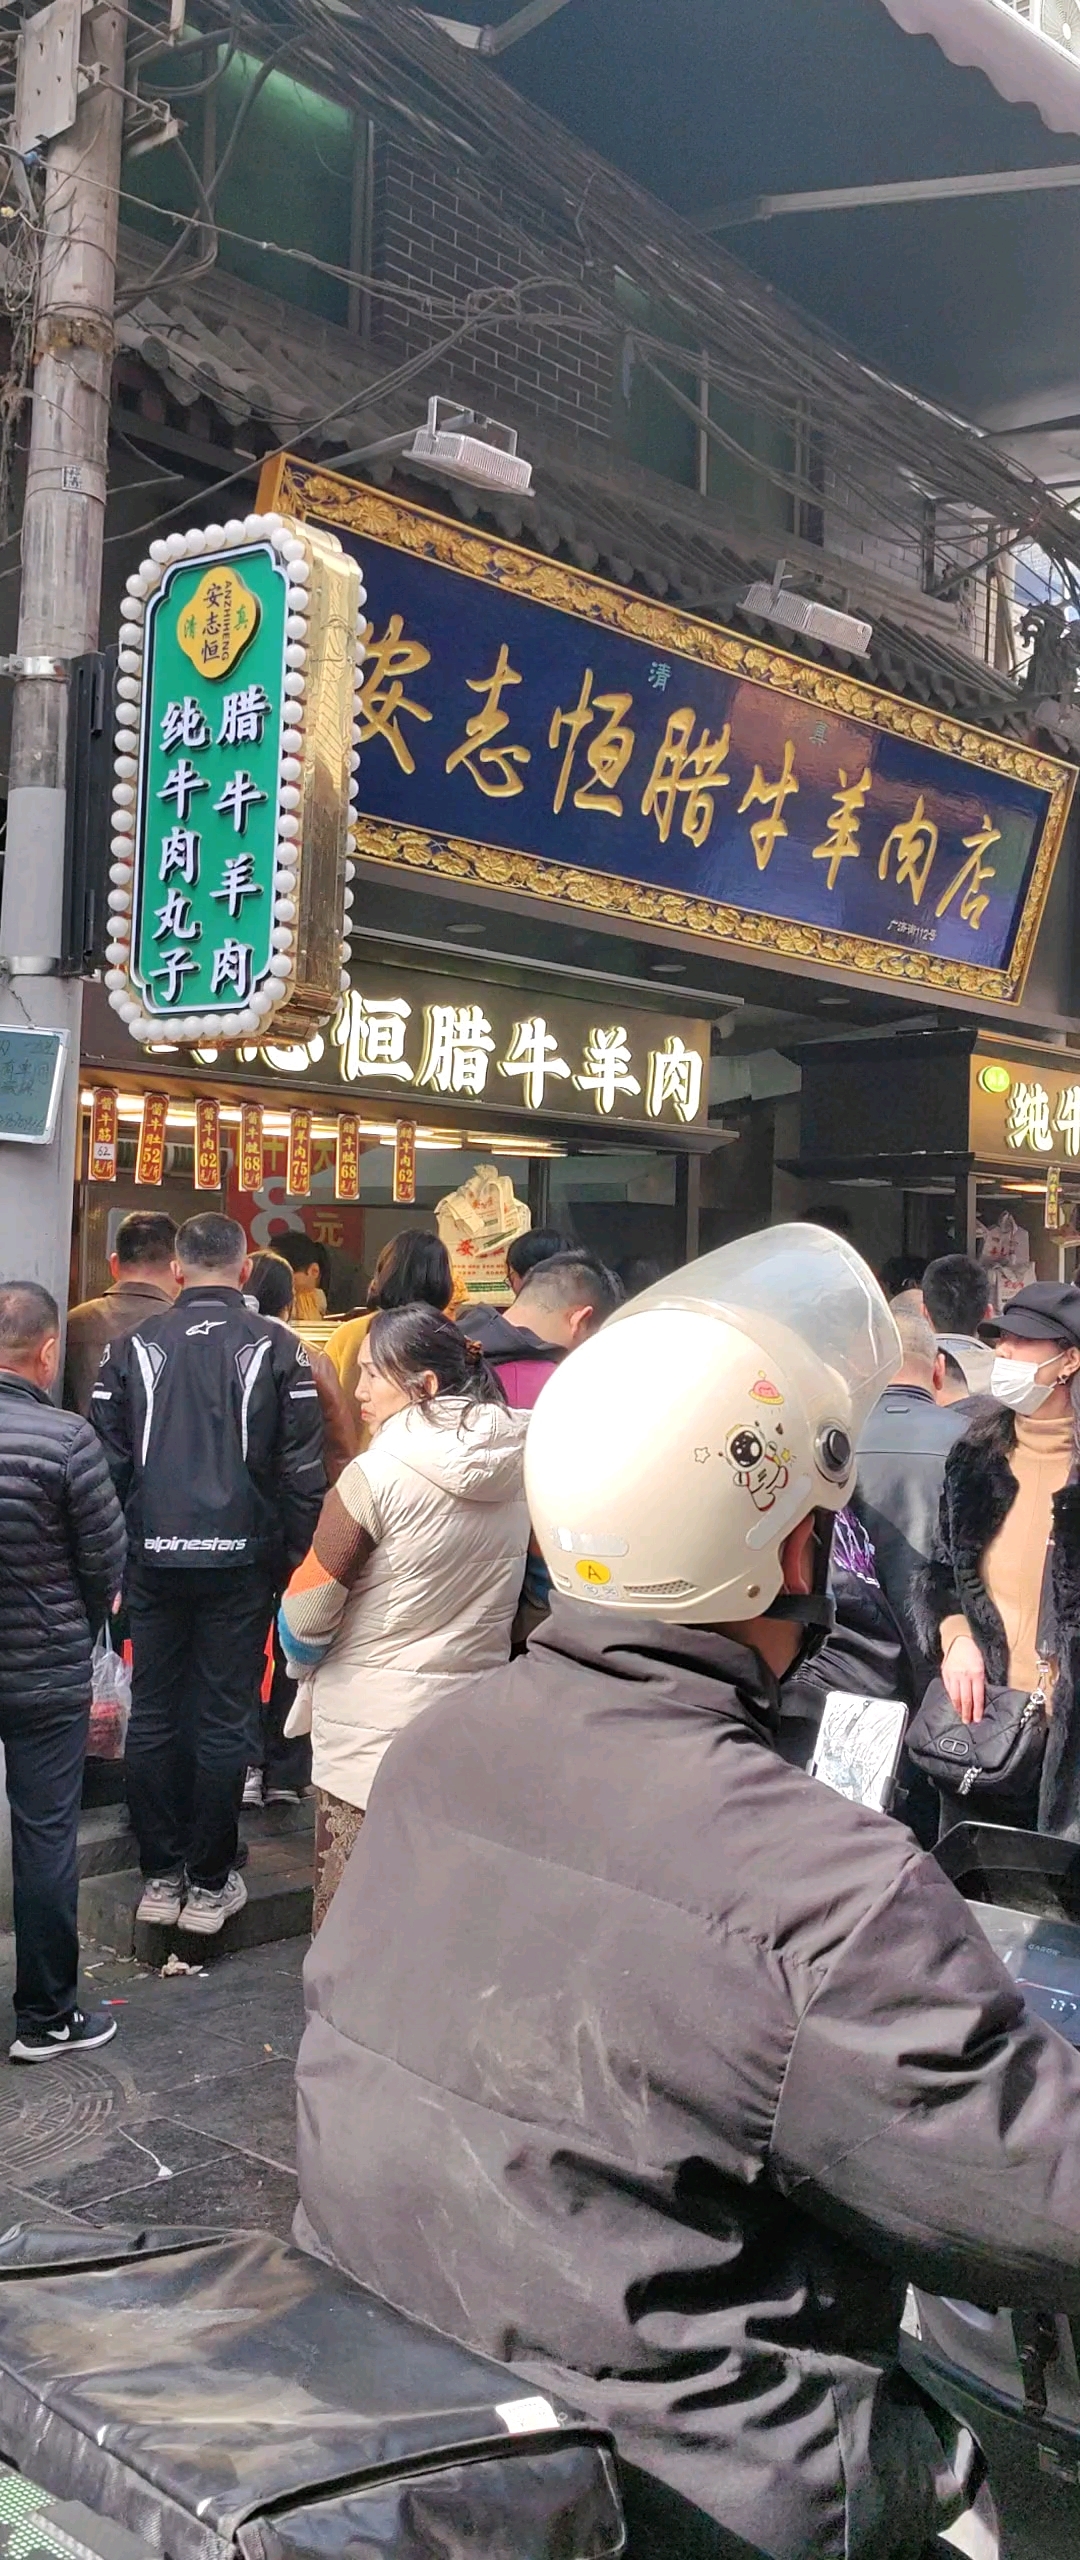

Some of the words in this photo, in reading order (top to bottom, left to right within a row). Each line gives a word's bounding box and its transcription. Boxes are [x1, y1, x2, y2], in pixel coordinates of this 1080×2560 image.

[201, 583, 224, 664] 安志恒
[222, 580, 232, 661] ANZHIHENG
[234, 603, 248, 631] 真
[647, 660, 673, 692] 清
[358, 614, 1001, 930] 安志恒腊牛羊肉店
[149, 696, 208, 1002] 纯牛肉丸子
[210, 684, 271, 998] 腊牛羊肉
[143, 1149, 161, 1164] 52
[200, 1152, 217, 1168] 62
[244, 1156, 261, 1171] 68
[292, 1161, 308, 1176] 75
[340, 1164, 357, 1179] 68
[399, 1169, 413, 1183] 62
[144, 1536, 247, 1552] alpinestars
[587, 1564, 602, 1581] A
